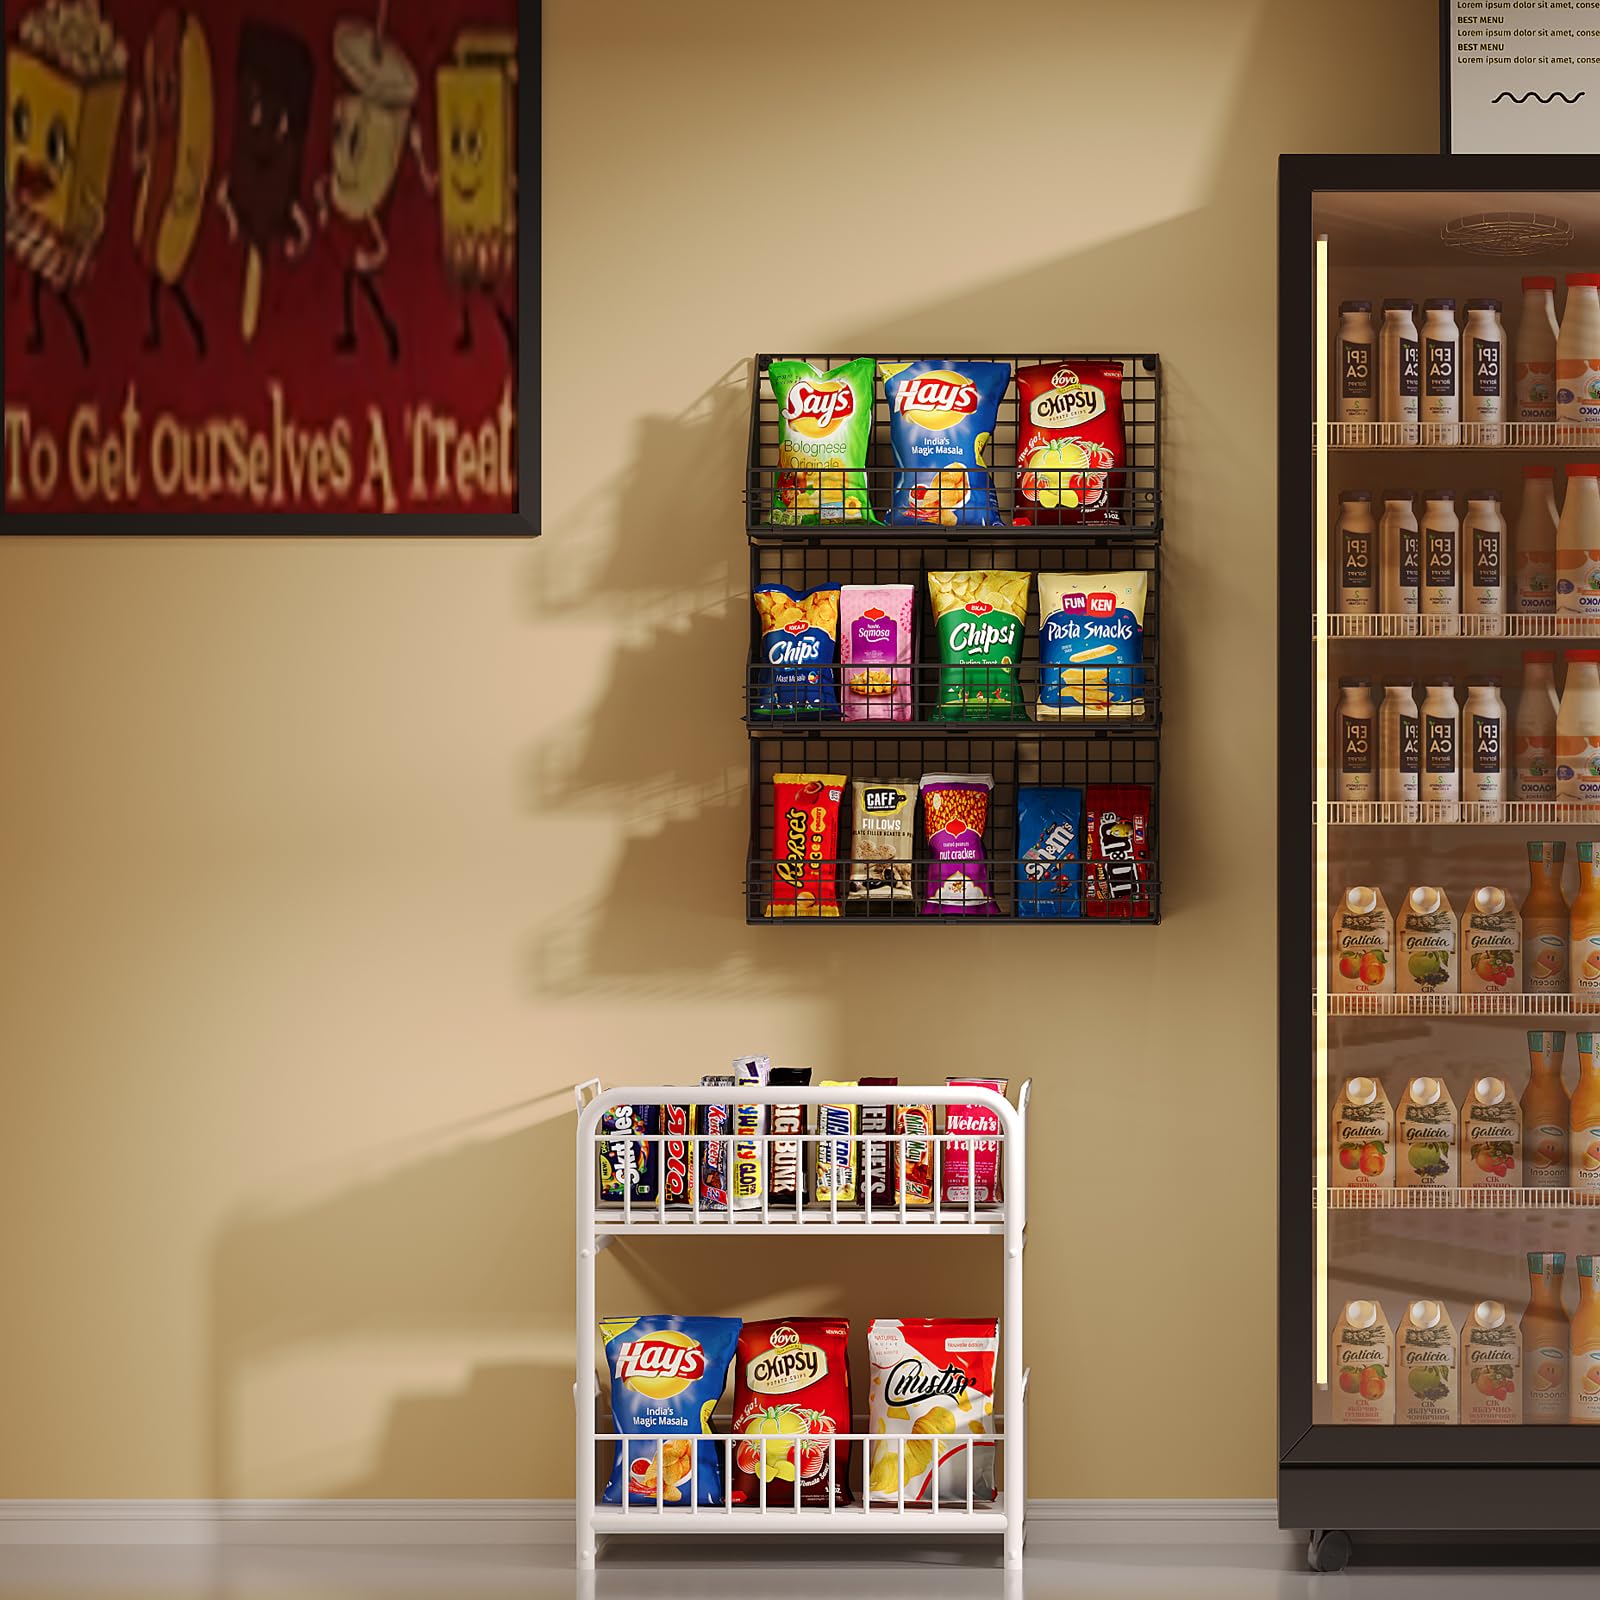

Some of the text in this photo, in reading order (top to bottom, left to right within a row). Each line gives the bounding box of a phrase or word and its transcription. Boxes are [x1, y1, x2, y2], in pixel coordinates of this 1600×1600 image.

[1485, 1, 1510, 10] ipsum
[1513, 1, 1536, 9] dolor
[1538, 1, 1548, 9] sit
[1550, 2, 1574, 10] amet,
[1458, 16, 1504, 24] BEST MENU
[1486, 29, 1511, 38] ipsum
[1513, 29, 1536, 37] dolor
[1538, 29, 1548, 37] sit
[1458, 56, 1483, 64] Lorem
[1486, 56, 1511, 65] ipsum
[1514, 56, 1536, 64] dolor
[1539, 56, 1549, 64] sit
[1551, 57, 1575, 65] amet,
[894, 380, 975, 413] Hay's
[782, 381, 850, 428] Say's
[4, 406, 58, 501] To
[69, 380, 141, 502] Get
[360, 405, 398, 513] A
[404, 377, 514, 501] Treat
[784, 440, 847, 457] Bolognese
[924, 438, 950, 446] India's
[912, 446, 963, 456] Magic Masala
[1064, 597, 1112, 612] FUN KEN
[858, 627, 890, 642] Samosa
[1048, 619, 1132, 642] Pasta Snacks
[950, 623, 1015, 653] Chipsi
[769, 639, 820, 665] Chips
[867, 792, 896, 806] CAFF
[940, 848, 976, 860] nut cracker
[1342, 935, 1384, 948] Galicia
[1406, 936, 1450, 949] Galicia
[1471, 936, 1515, 948] Galicia
[946, 1116, 996, 1131] Welch's
[1342, 1126, 1384, 1139] Galicia
[1406, 1127, 1450, 1140] Galicia
[1471, 1126, 1515, 1139] Galicia
[906, 1141, 925, 1161] May
[774, 1141, 797, 1192] BUNK
[739, 1163, 757, 1184] GLO
[912, 1184, 922, 1194] 2
[615, 1342, 698, 1379] Hay's
[1342, 1350, 1384, 1363] Galicia
[1406, 1351, 1450, 1364] Galicia
[1471, 1350, 1514, 1363] Galicia
[646, 1408, 674, 1416] India's
[633, 1416, 688, 1427] Magic Masala
